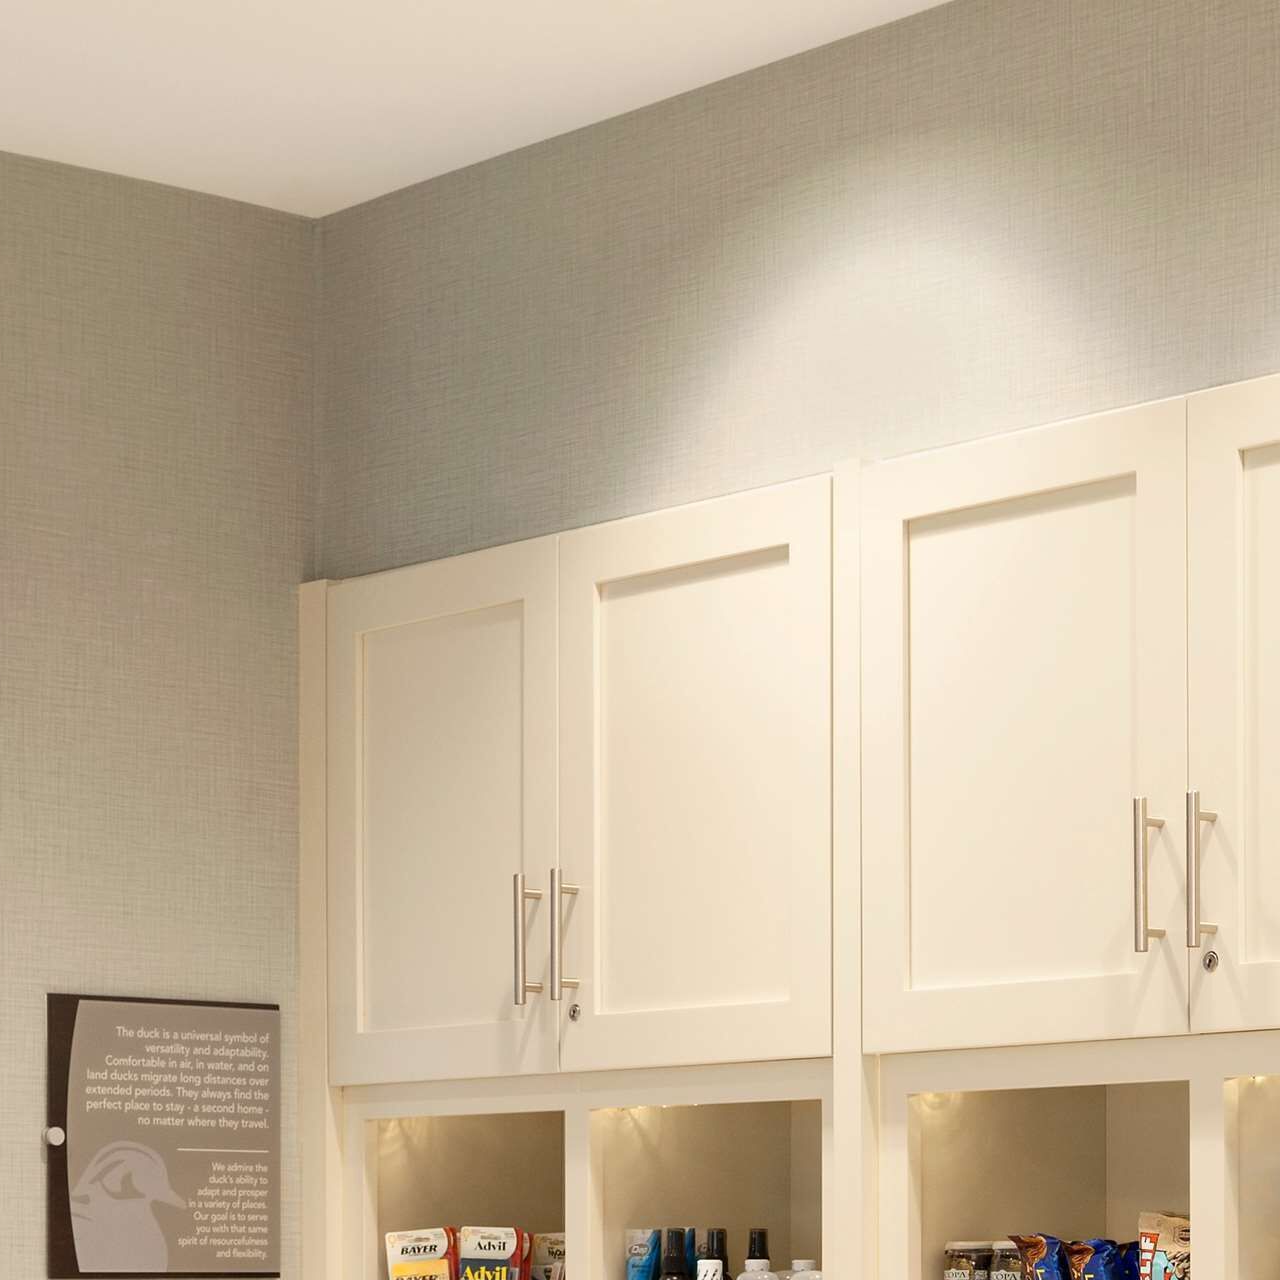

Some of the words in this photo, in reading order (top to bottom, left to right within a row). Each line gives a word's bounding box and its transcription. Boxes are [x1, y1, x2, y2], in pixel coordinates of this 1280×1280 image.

[116, 1026, 134, 1038] The
[137, 1027, 160, 1039] duck
[163, 1028, 170, 1039] is
[181, 1029, 222, 1041] universal
[224, 1032, 257, 1045] symbol
[260, 1033, 269, 1043] of
[145, 1043, 190, 1057] versatility
[193, 1045, 211, 1056] and
[105, 1055, 166, 1068] Comfortable
[168, 1058, 177, 1068] in
[196, 1059, 204, 1070] in
[207, 1061, 235, 1072] water,
[238, 1061, 255, 1072] and
[257, 1063, 269, 1072] on
[87, 1068, 108, 1080] land
[110, 1069, 138, 1081] ducks
[141, 1071, 178, 1084] migrate
[180, 1072, 201, 1086] long
[203, 1073, 247, 1086] distances
[249, 1078, 269, 1086] over
[86, 1084, 132, 1095] extended
[134, 1086, 172, 1099] periods.
[176, 1086, 199, 1101] They
[201, 1088, 232, 1101] always
[234, 1088, 252, 1100] find
[254, 1089, 269, 1100] the
[86, 1098, 122, 1112] perfect
[124, 1099, 150, 1112] place
[153, 1102, 164, 1111] to
[165, 1102, 184, 1114] stay
[193, 1104, 199, 1112] a
[201, 1102, 235, 1113] second
[237, 1103, 264, 1114] home
[137, 1117, 150, 1125] no
[152, 1117, 184, 1126] matter
[187, 1116, 216, 1127] where
[219, 1117, 240, 1130] they
[242, 1117, 269, 1128] travel.
[212, 1162, 225, 1172] We
[227, 1162, 253, 1172] admire
[255, 1164, 268, 1172] the
[209, 1175, 234, 1184] duck's
[236, 1175, 258, 1187] ability
[197, 1187, 220, 1199] adapt
[222, 1187, 236, 1196] and
[238, 1190, 268, 1199] prosper
[204, 1200, 230, 1210] variety
[232, 1199, 240, 1208] of
[193, 1211, 208, 1220] Our
[211, 1211, 228, 1223] goal
[230, 1212, 236, 1221] is
[237, 1213, 246, 1221] to
[196, 1226, 210, 1236] you
[212, 1223, 229, 1233] with
[230, 1224, 245, 1233] that
[200, 1235, 208, 1245] of
[210, 1235, 268, 1246] resourcefulness
[475, 1240, 507, 1252] Advil
[216, 1248, 231, 1258] and
[401, 1243, 438, 1256] BAYER
